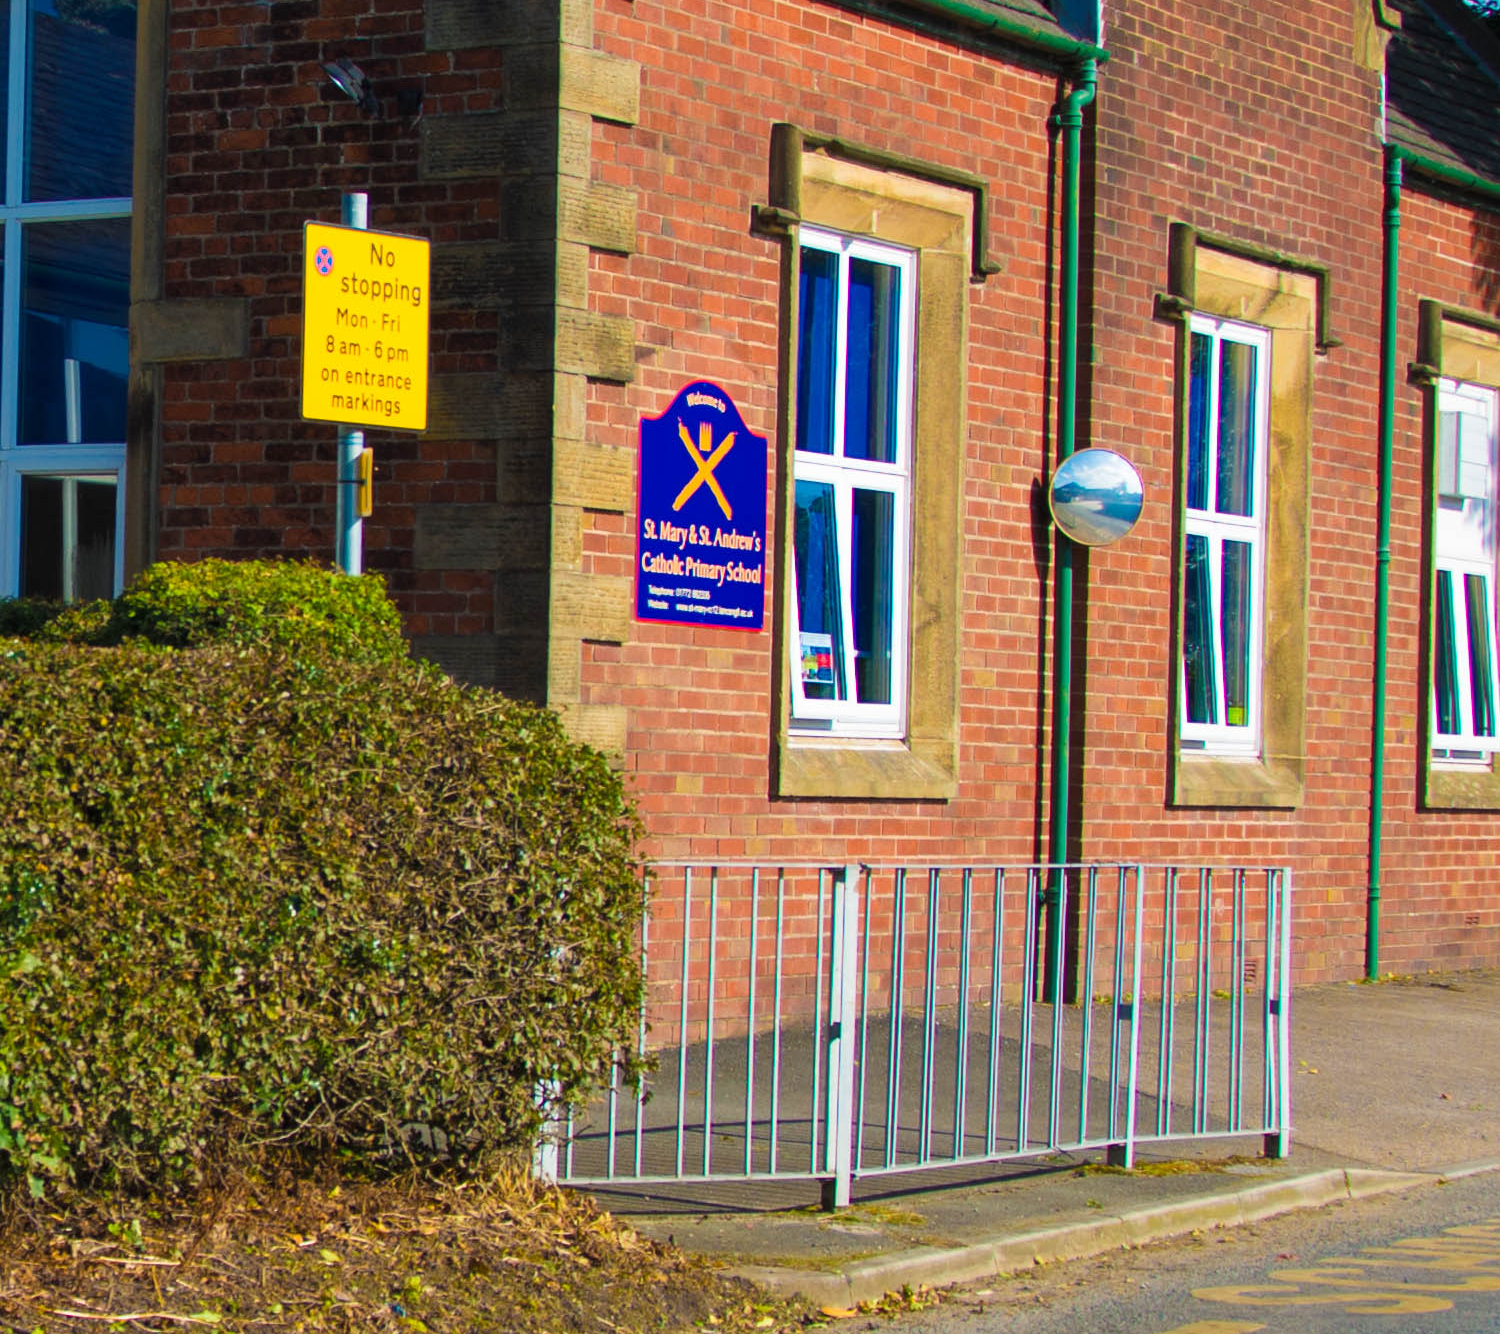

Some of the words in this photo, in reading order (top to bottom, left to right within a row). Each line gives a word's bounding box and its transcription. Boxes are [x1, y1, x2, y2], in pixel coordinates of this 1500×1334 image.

[370, 242, 396, 268] No
[341, 272, 421, 307] stopping
[336, 307, 368, 328] Mon
[381, 313, 401, 332] Fri
[340, 341, 361, 356] am
[386, 346, 409, 364] pm
[321, 367, 340, 382] on
[345, 368, 412, 391] entrance
[331, 393, 401, 417] markings
[686, 391, 718, 409] Welcome
[717, 398, 726, 414] to
[644, 518, 658, 540] St.
[660, 520, 688, 550] Mary
[688, 524, 698, 545] &
[699, 525, 713, 546] St.
[713, 527, 762, 553] Andrew's
[641, 551, 685, 576] Catholic
[685, 556, 726, 587] Primary
[726, 561, 762, 585] School
